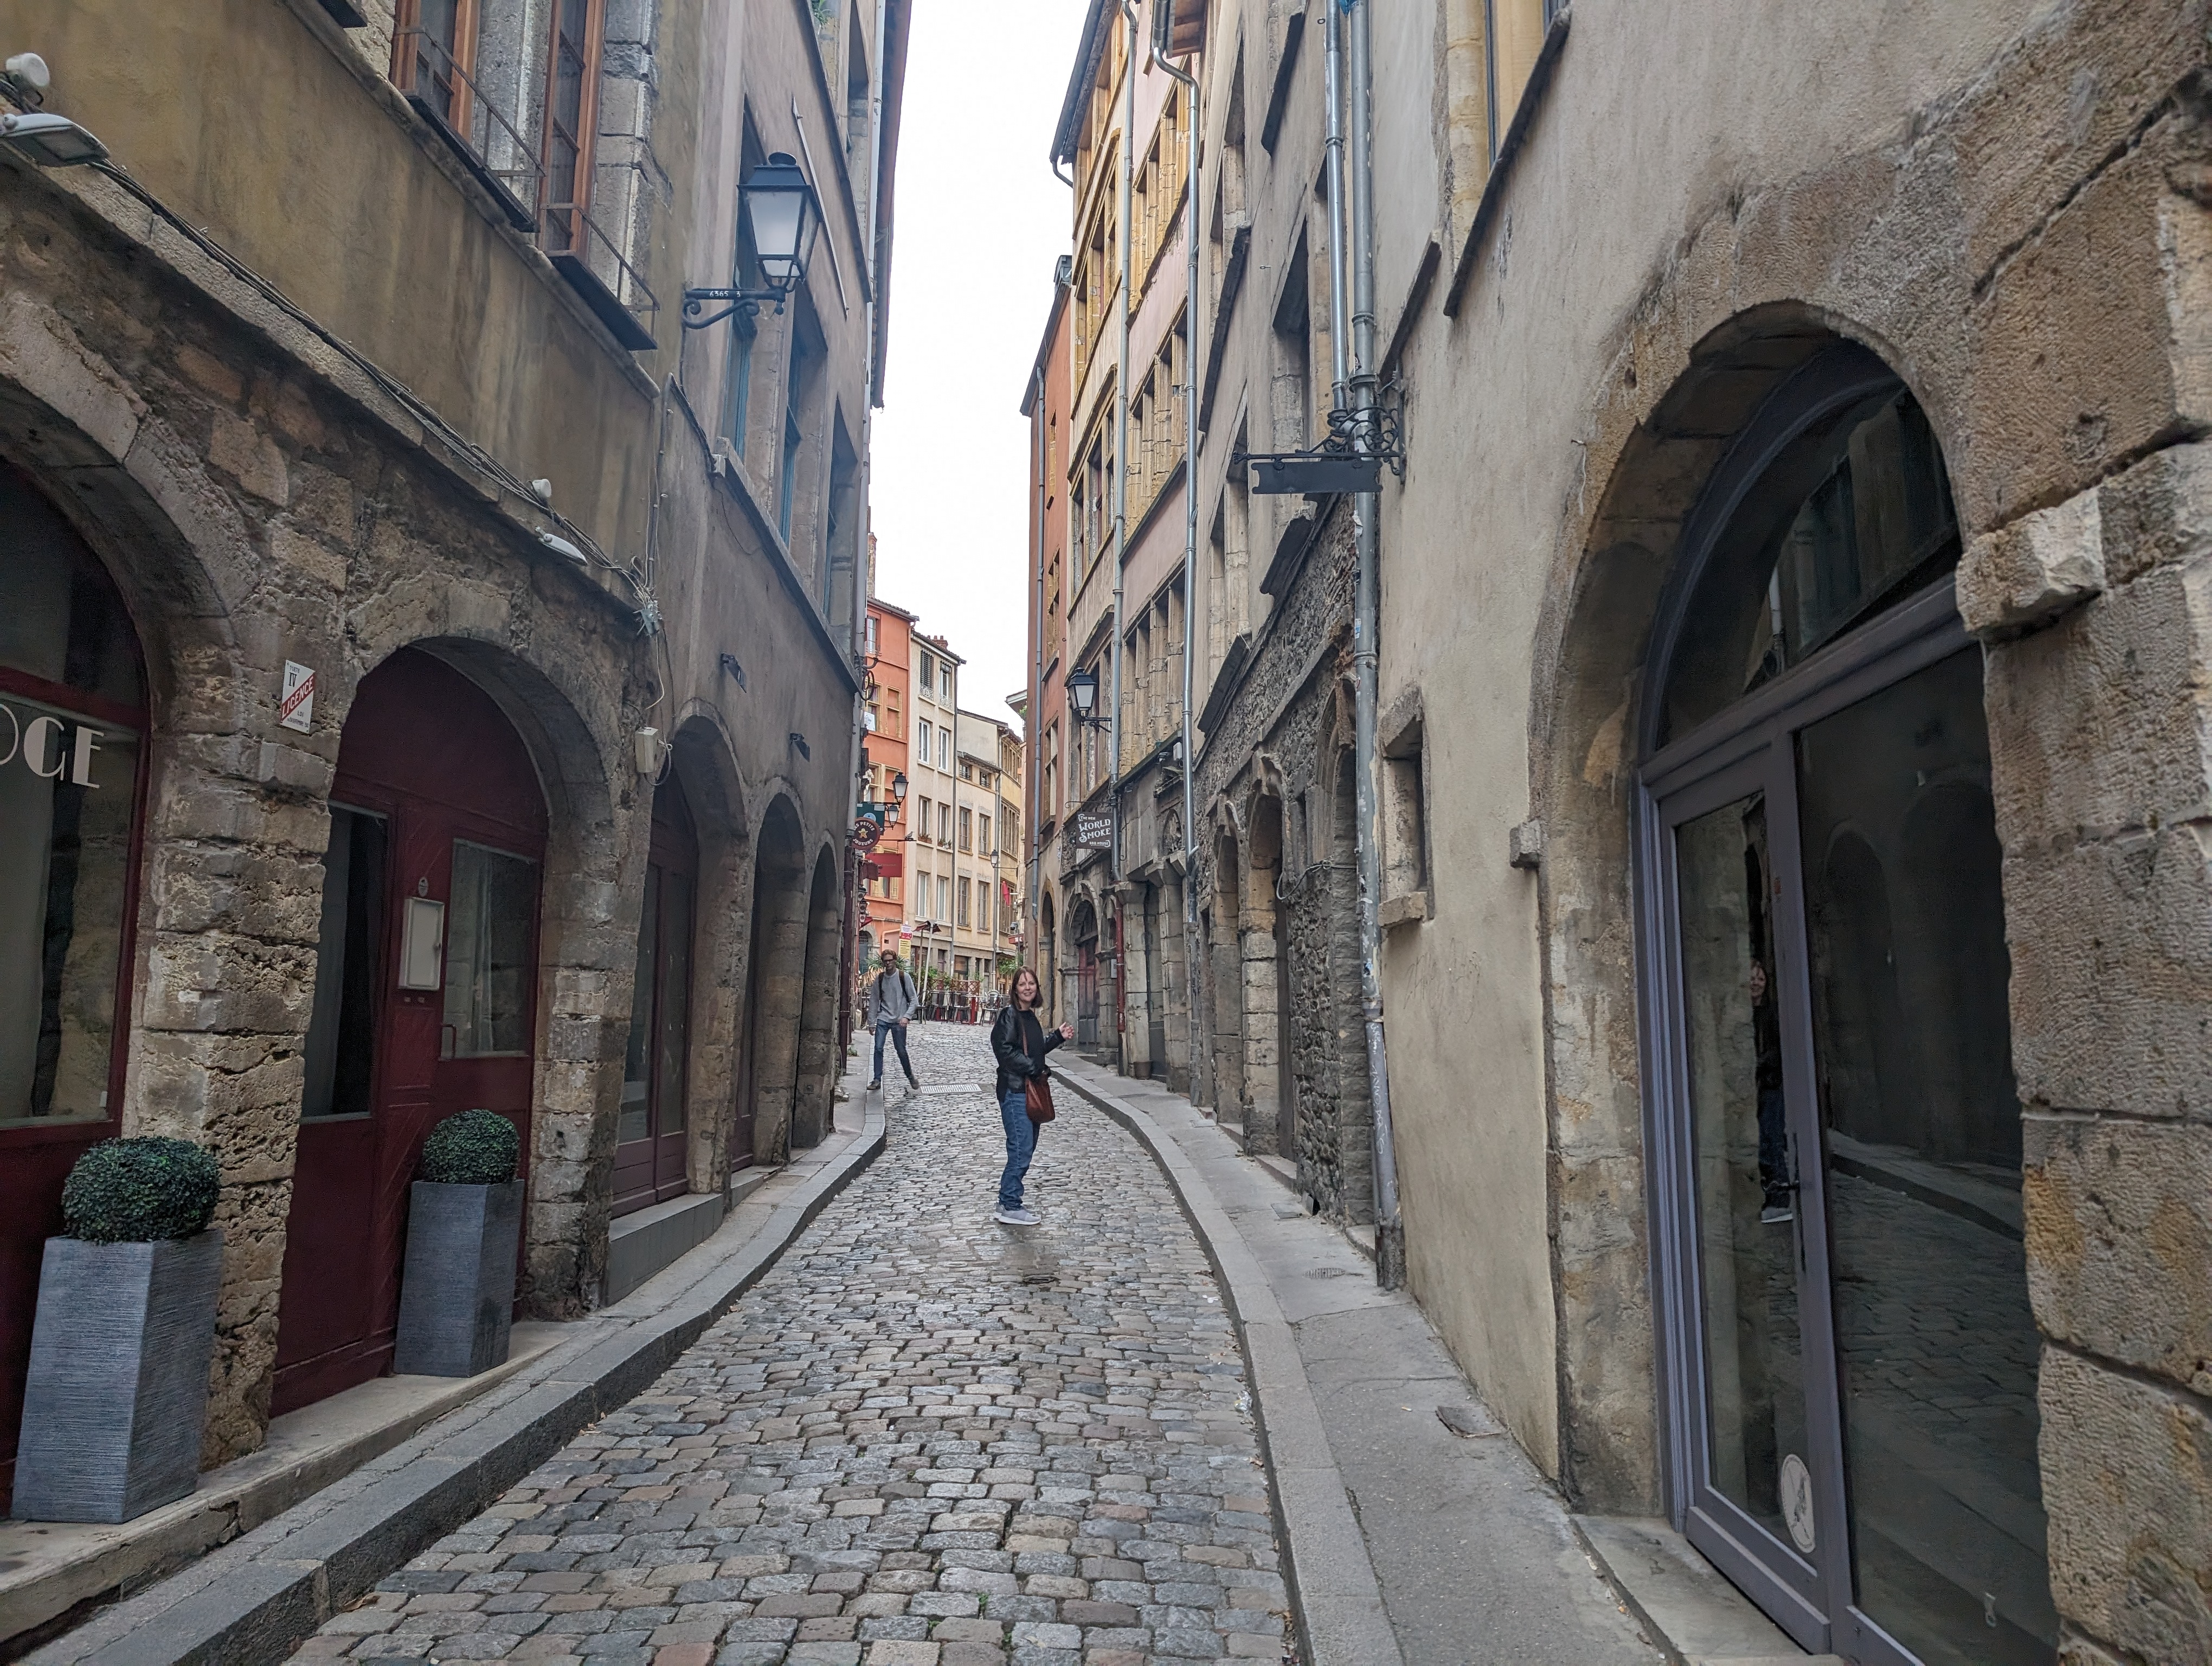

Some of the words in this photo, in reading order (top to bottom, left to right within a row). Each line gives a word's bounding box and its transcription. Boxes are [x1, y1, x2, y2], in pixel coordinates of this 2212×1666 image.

[288, 672, 297, 688] IV
[282, 675, 314, 719] LICENCE
[860, 821, 875, 831] PETITS
[1078, 819, 1111, 832] WORLD
[852, 838, 873, 846] JOUEURS
[1079, 828, 1111, 843] SMOKE
